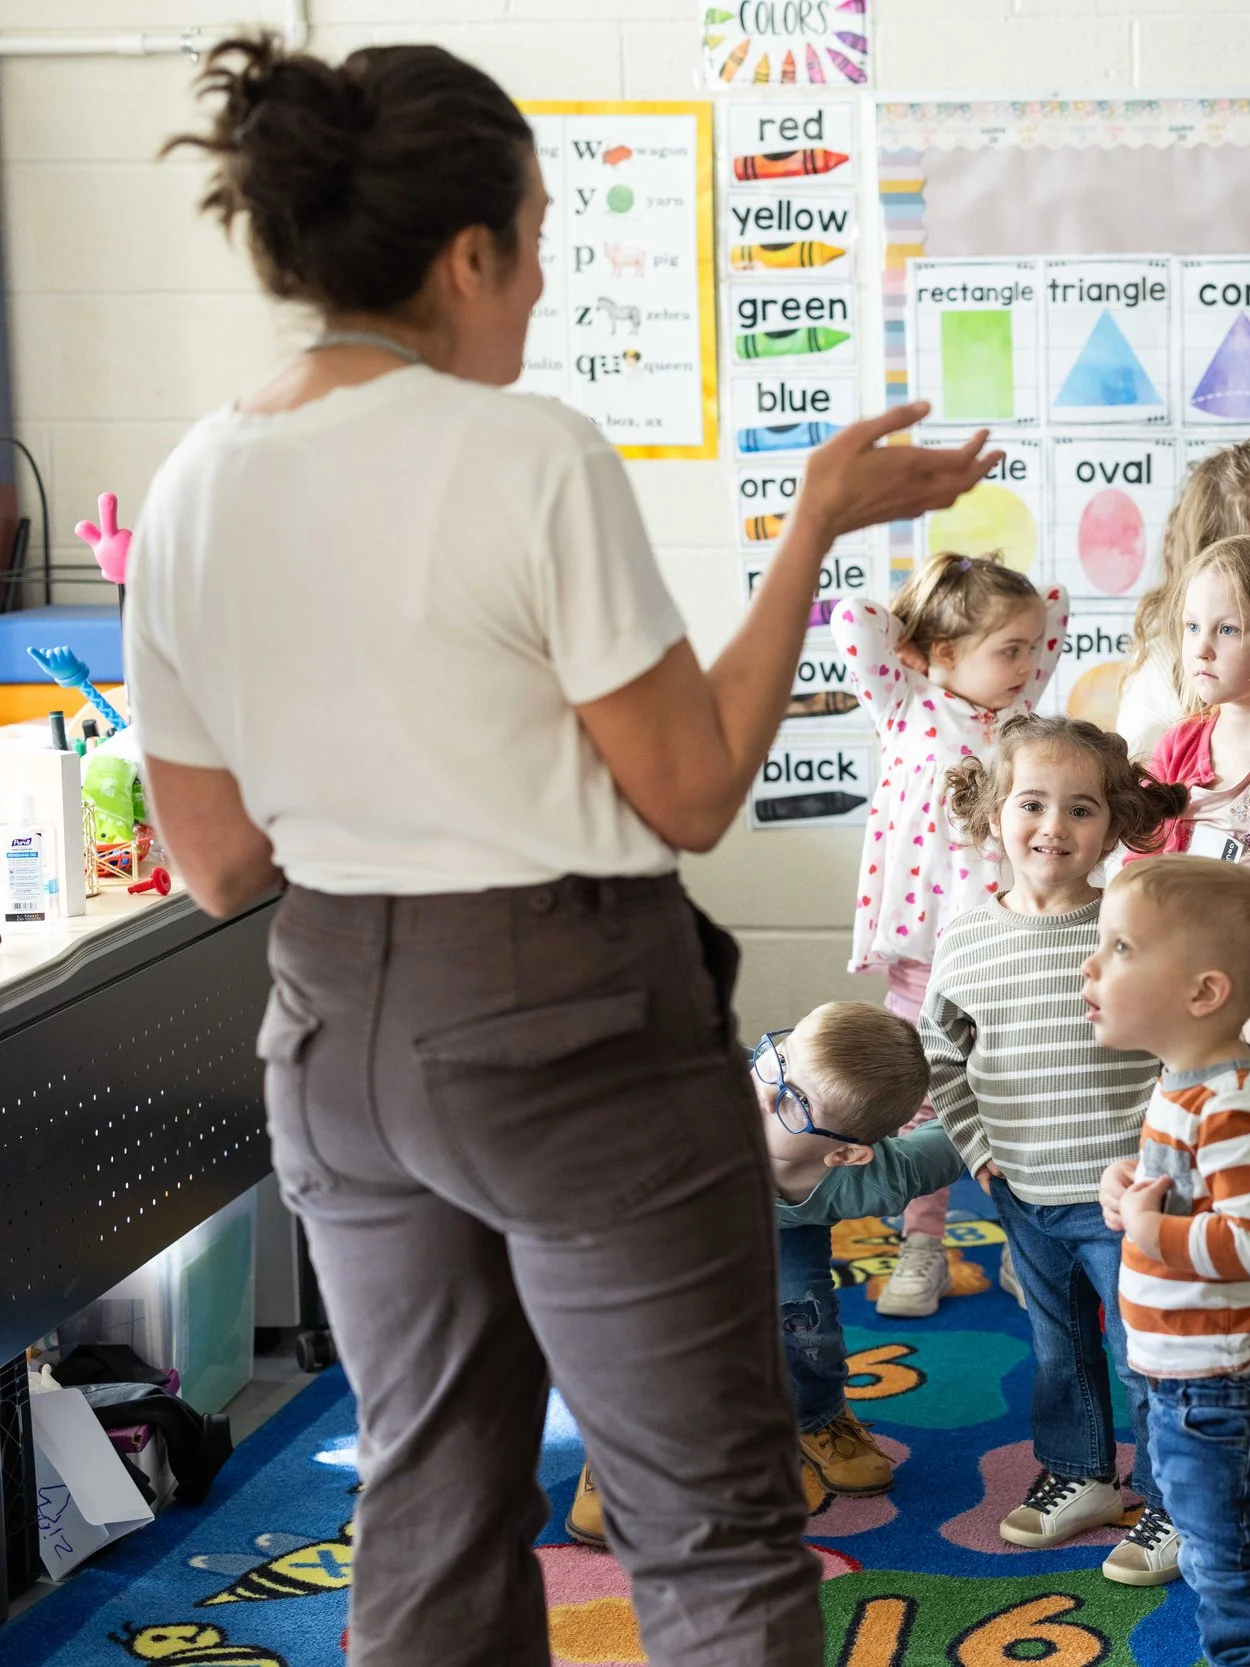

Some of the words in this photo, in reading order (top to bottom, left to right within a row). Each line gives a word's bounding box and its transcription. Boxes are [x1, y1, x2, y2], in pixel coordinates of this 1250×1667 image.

[739, 0, 829, 35] COLORS
[759, 110, 823, 141] red
[637, 147, 689, 159] wagon
[647, 197, 684, 209] yarn
[732, 200, 847, 236] yellow
[573, 244, 595, 271] p
[653, 252, 679, 267] pig
[918, 282, 1034, 306] rectangle
[1048, 276, 1166, 307] triangle
[574, 306, 593, 326] z
[646, 309, 691, 321] zebra
[738, 298, 847, 328] green
[644, 359, 694, 373] queen
[757, 383, 830, 412] blue
[1076, 453, 1153, 484] oval
[763, 752, 858, 782] black
[838, 1592, 1113, 1667] 16
